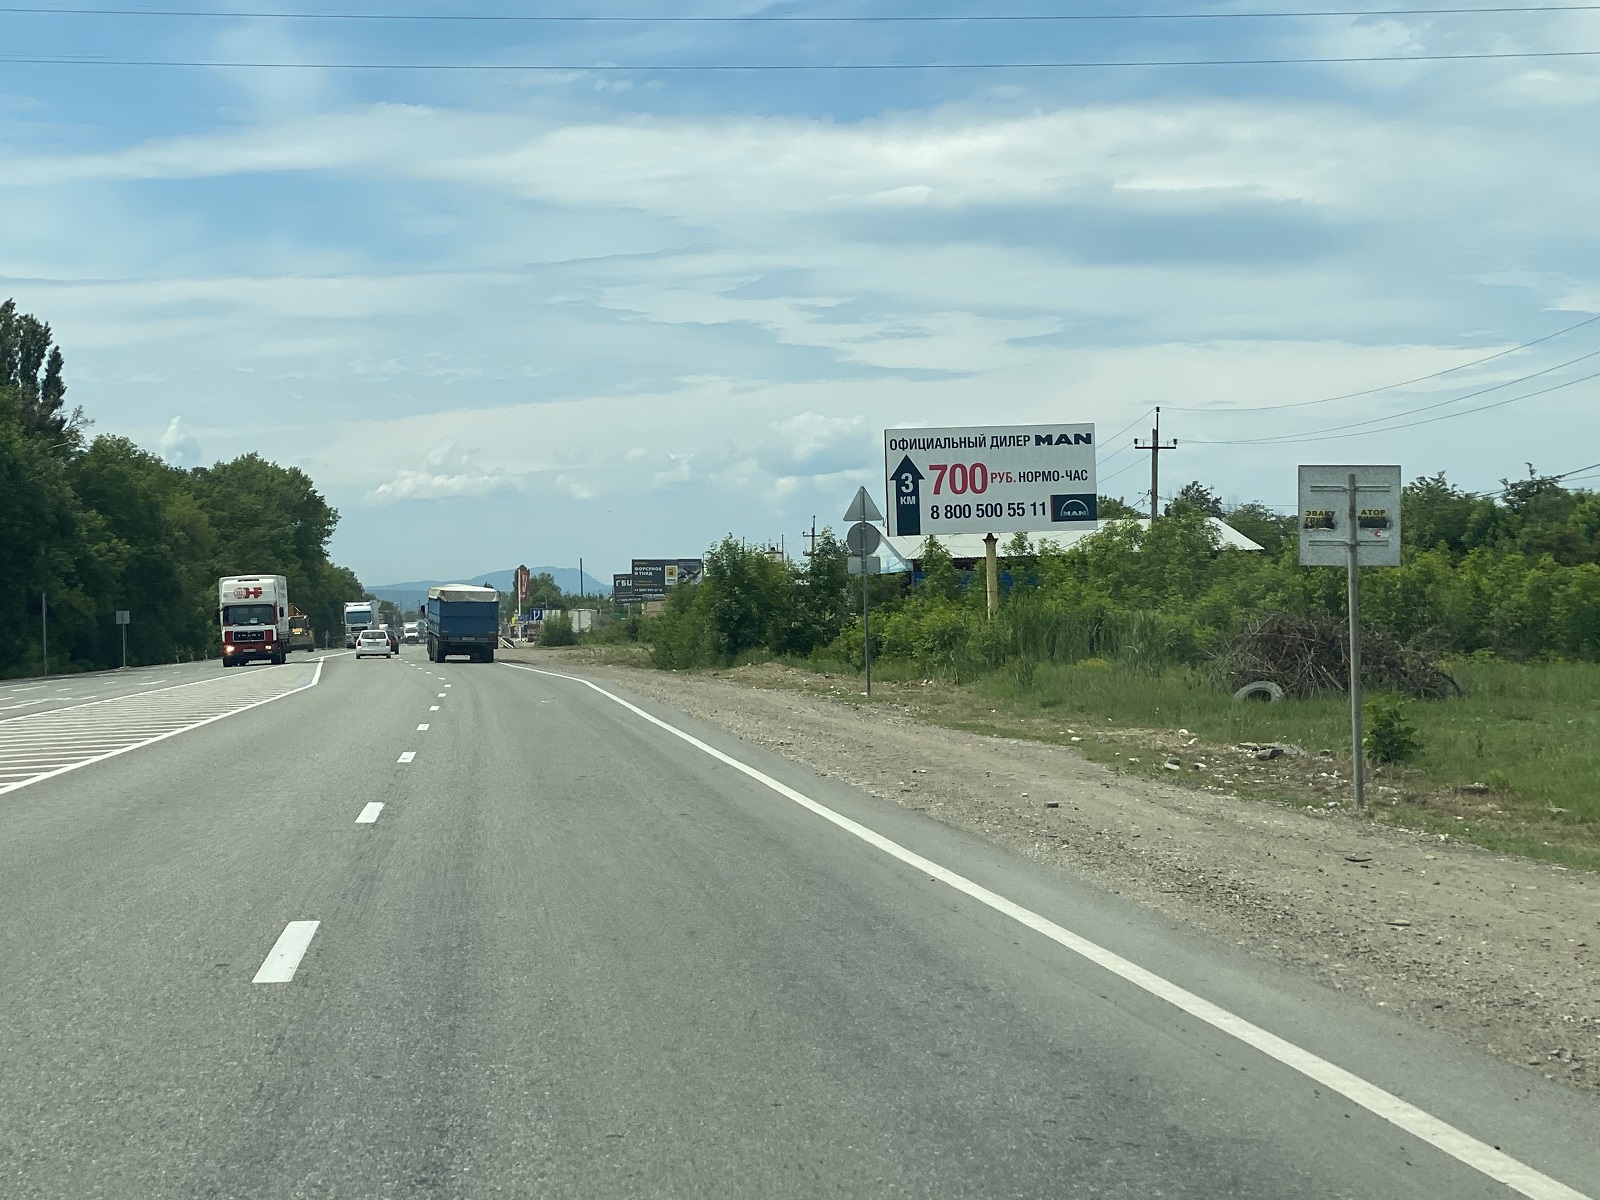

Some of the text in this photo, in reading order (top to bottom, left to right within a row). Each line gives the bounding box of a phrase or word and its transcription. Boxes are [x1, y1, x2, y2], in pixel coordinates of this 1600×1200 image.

[889, 433, 1092, 451] ОФИЦИАЛЬНЫЙ ДИЛЕР MAN
[901, 472, 914, 493] 3
[928, 462, 1088, 495] 700 РУБ. НОРМО-ЧАС
[900, 496, 916, 505] КМ
[930, 501, 1046, 519] 8 800 500 55 11
